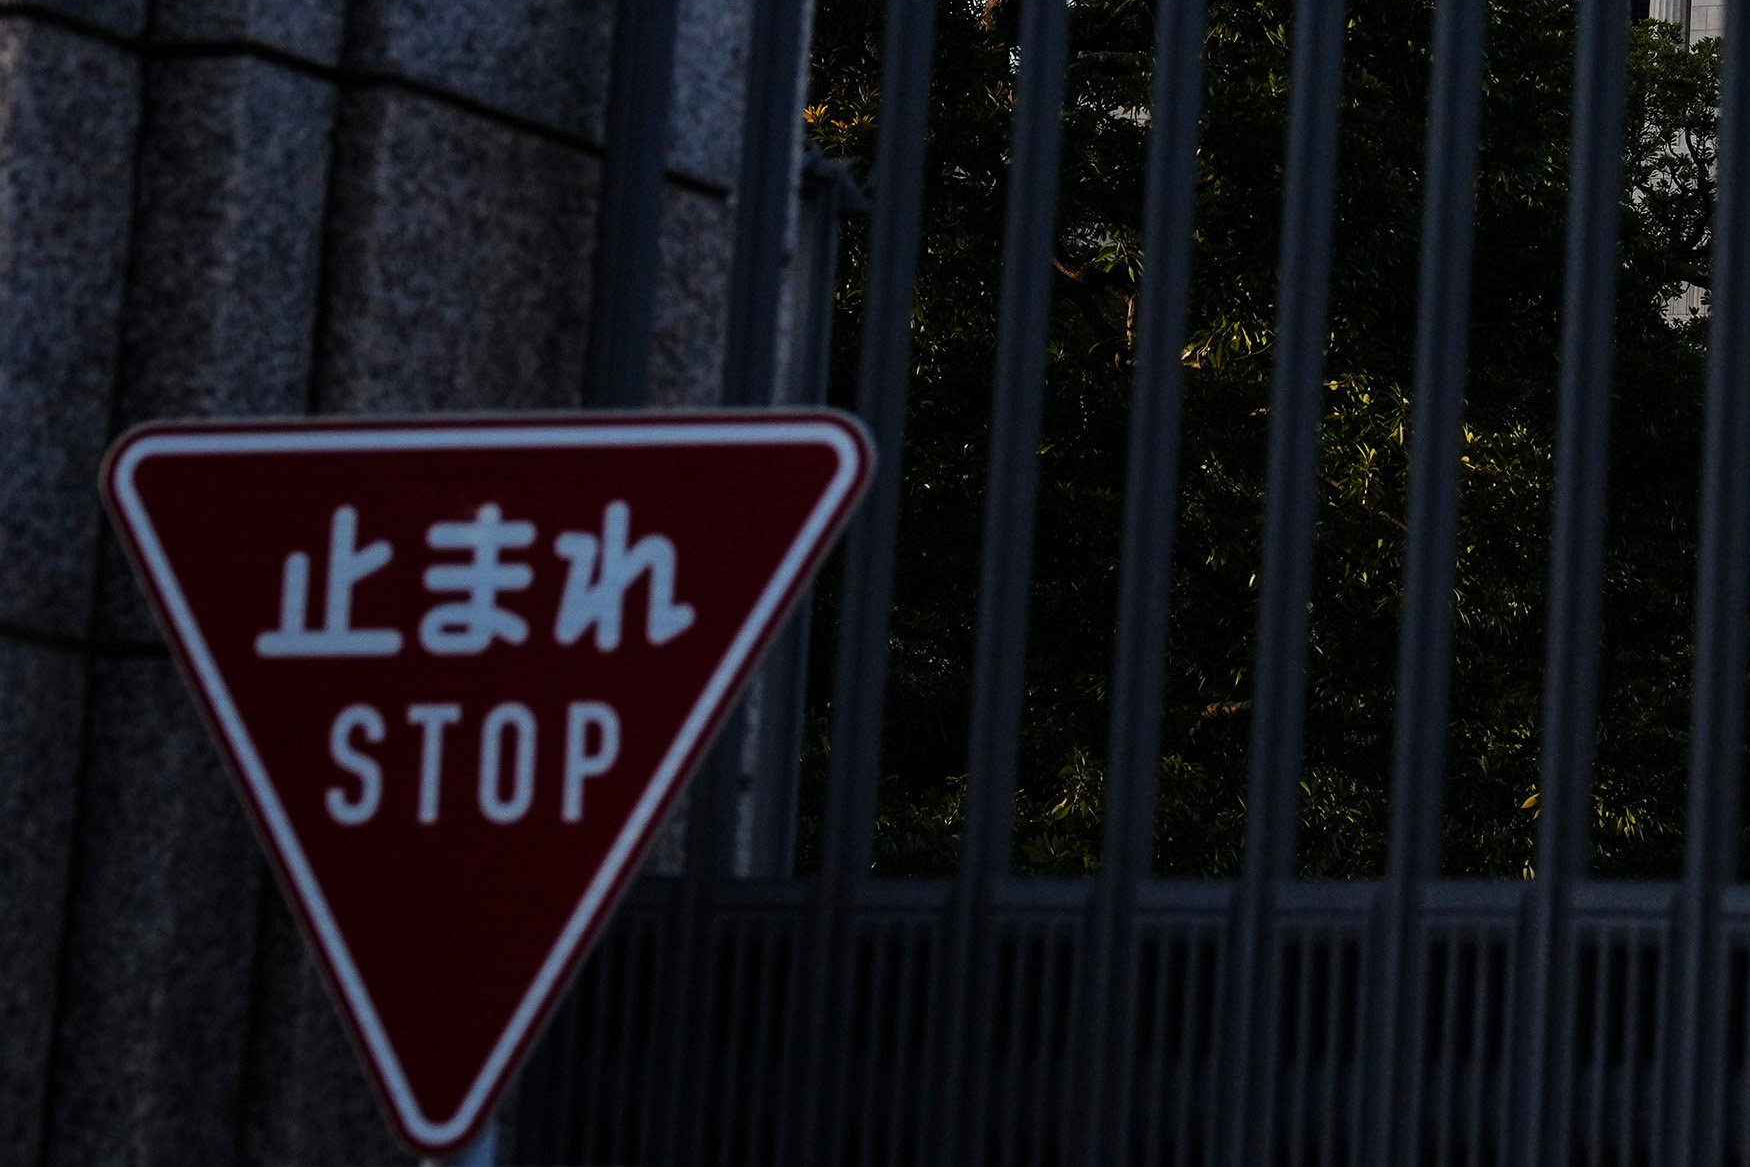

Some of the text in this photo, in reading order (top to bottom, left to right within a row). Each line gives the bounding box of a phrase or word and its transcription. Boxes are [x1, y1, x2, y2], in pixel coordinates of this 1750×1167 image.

[256, 501, 695, 656] 止まれ
[327, 701, 620, 824] STOP
